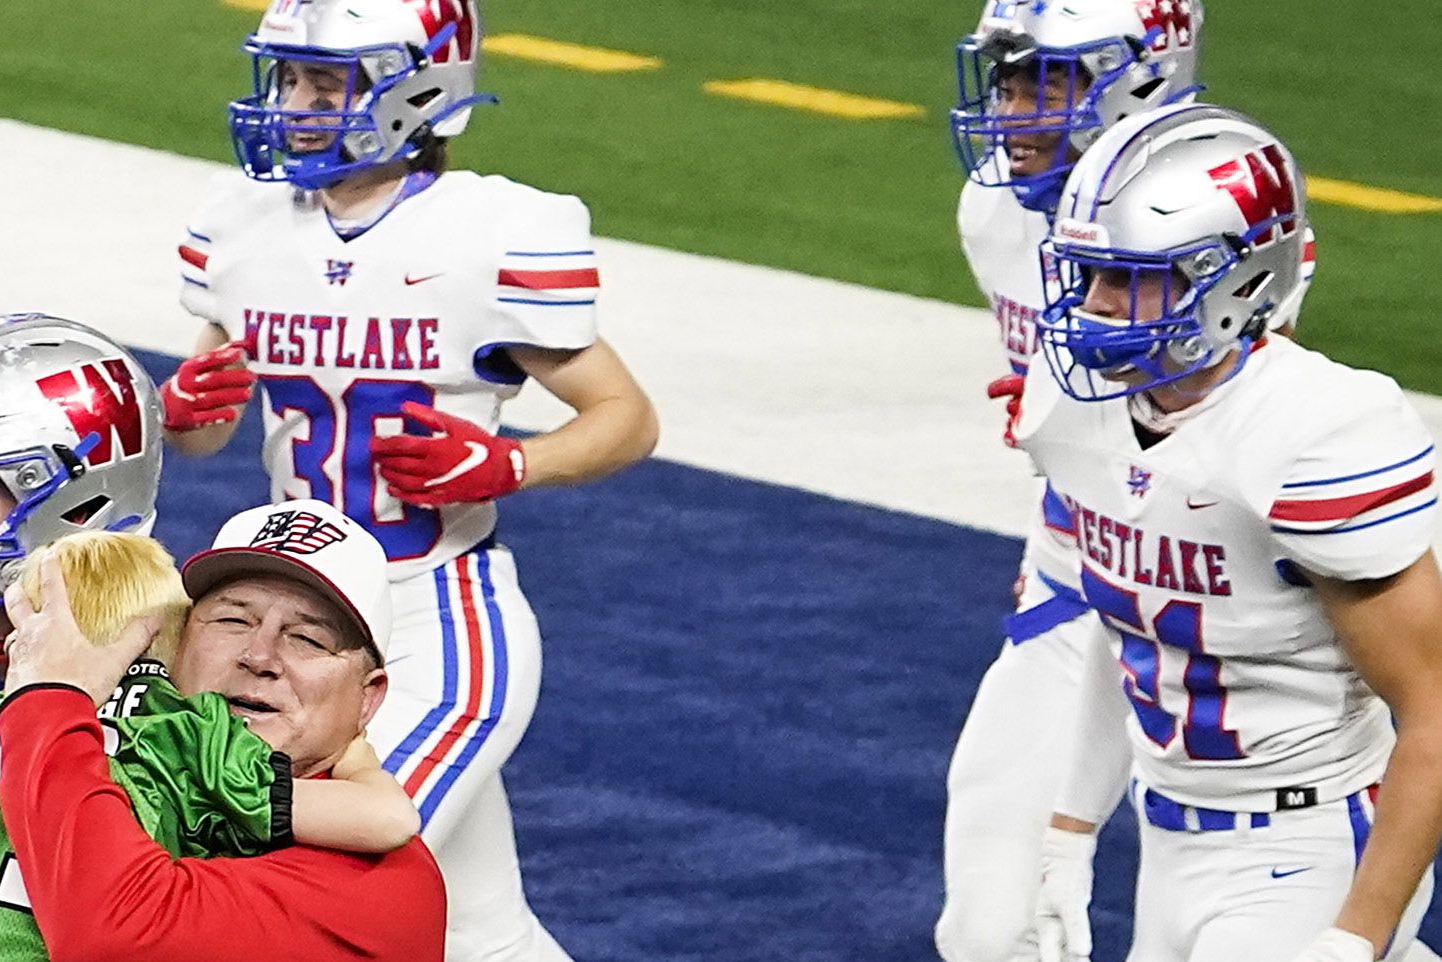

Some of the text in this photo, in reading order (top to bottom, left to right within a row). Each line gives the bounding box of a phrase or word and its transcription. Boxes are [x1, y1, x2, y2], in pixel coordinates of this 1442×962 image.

[1205, 143, 1298, 247] W
[244, 308, 441, 371] WESTLAKE
[35, 357, 144, 468] W
